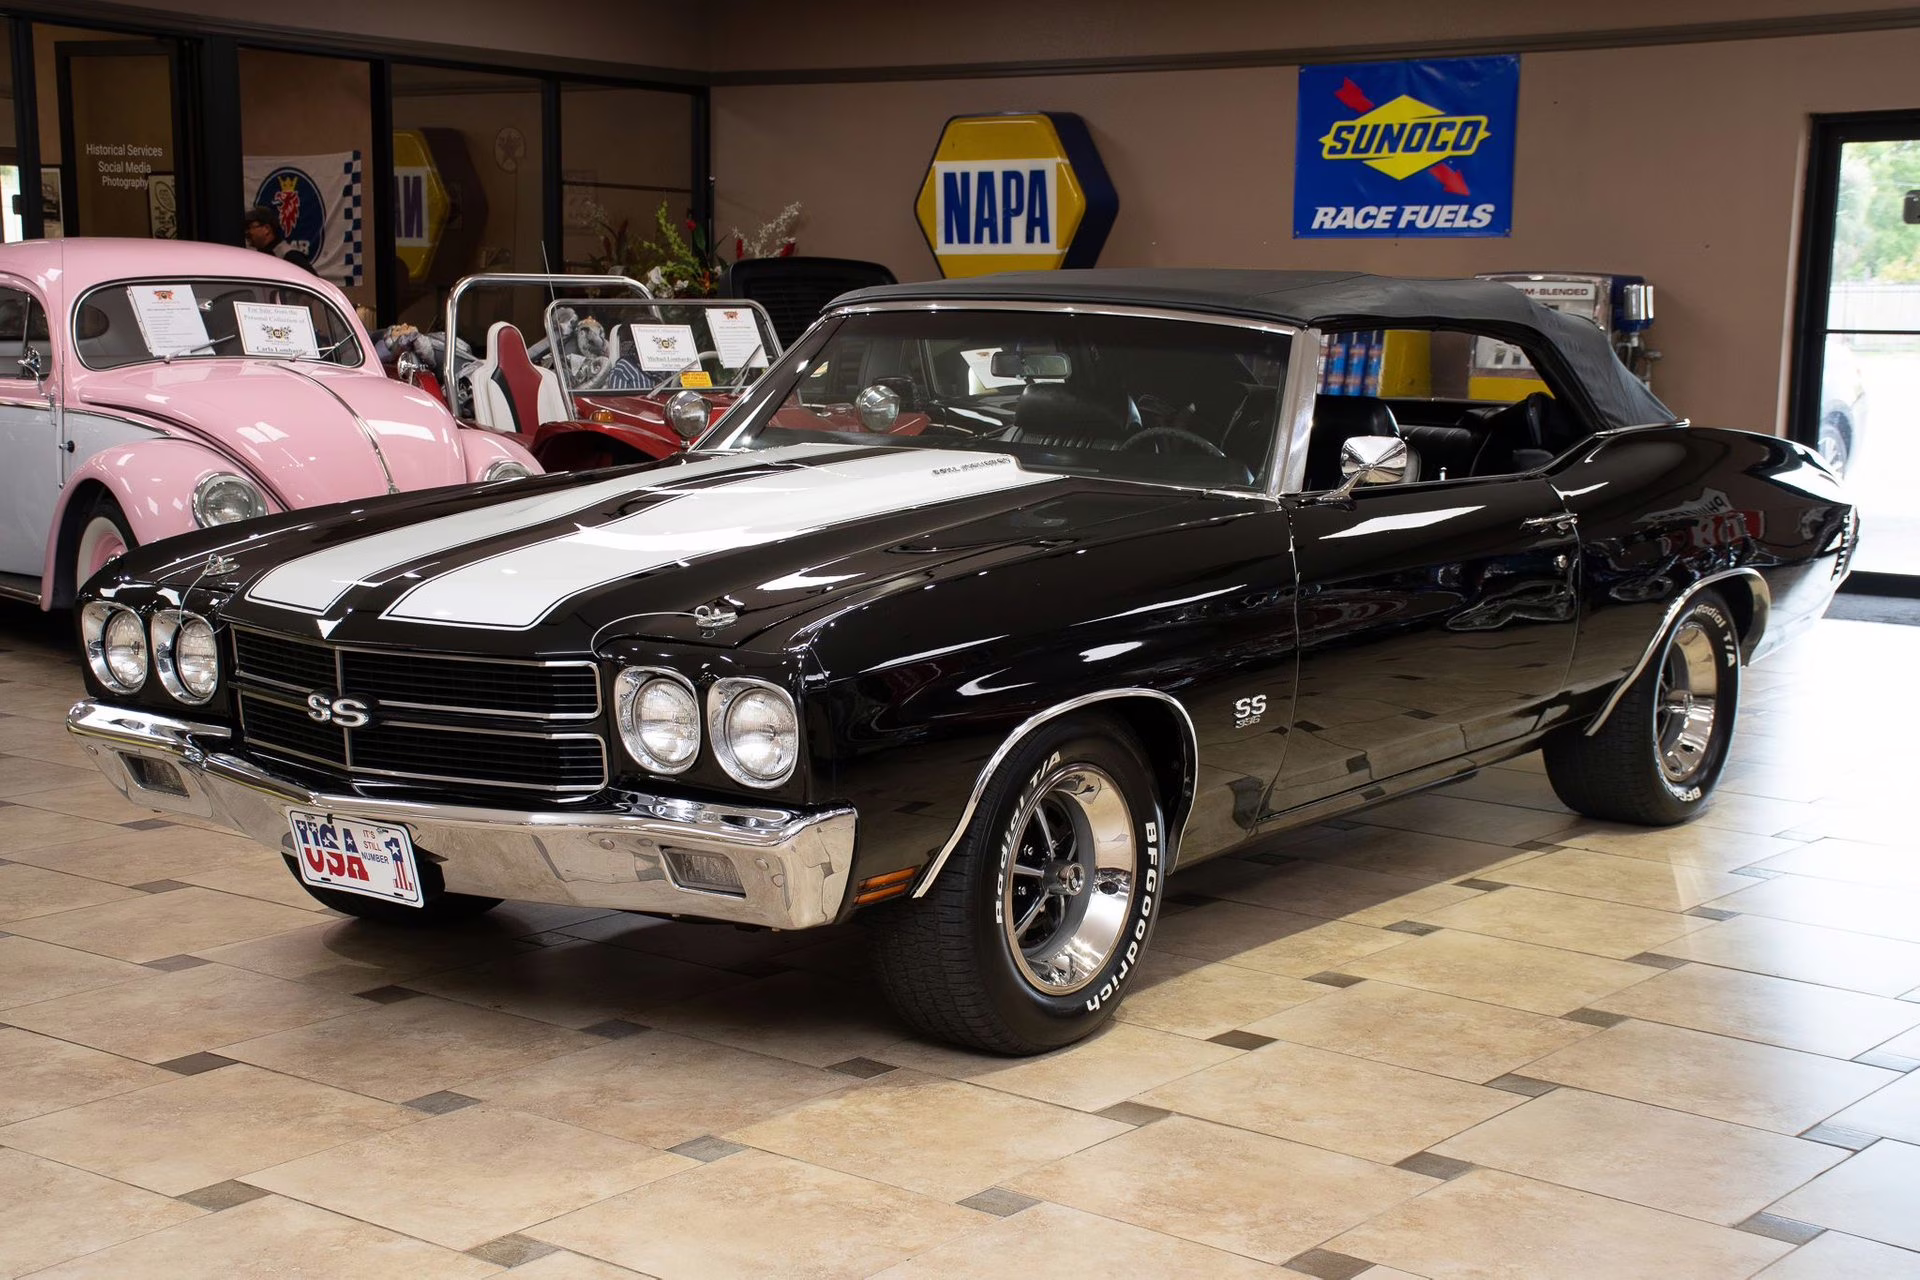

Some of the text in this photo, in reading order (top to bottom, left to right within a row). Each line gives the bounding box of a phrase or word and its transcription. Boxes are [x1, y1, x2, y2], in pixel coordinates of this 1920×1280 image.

[86, 144, 163, 157] Historical Services
[1327, 120, 1483, 155] SUNOCO
[98, 161, 152, 174] Social Media
[102, 175, 149, 190] Photography
[943, 170, 1050, 244] NAPA
[1311, 204, 1495, 229] RACE FUELS
[1694, 604, 1736, 667] Radial T/A
[308, 695, 370, 727] SS
[1234, 694, 1267, 718] SS
[363, 829, 376, 840] IT'S
[363, 841, 382, 852] STILL
[995, 750, 1062, 924] Radial T/A
[295, 820, 370, 881] USA
[361, 852, 390, 865] NUMBER
[384, 837, 414, 891] 1
[1086, 822, 1158, 1012] BFGoodrich
